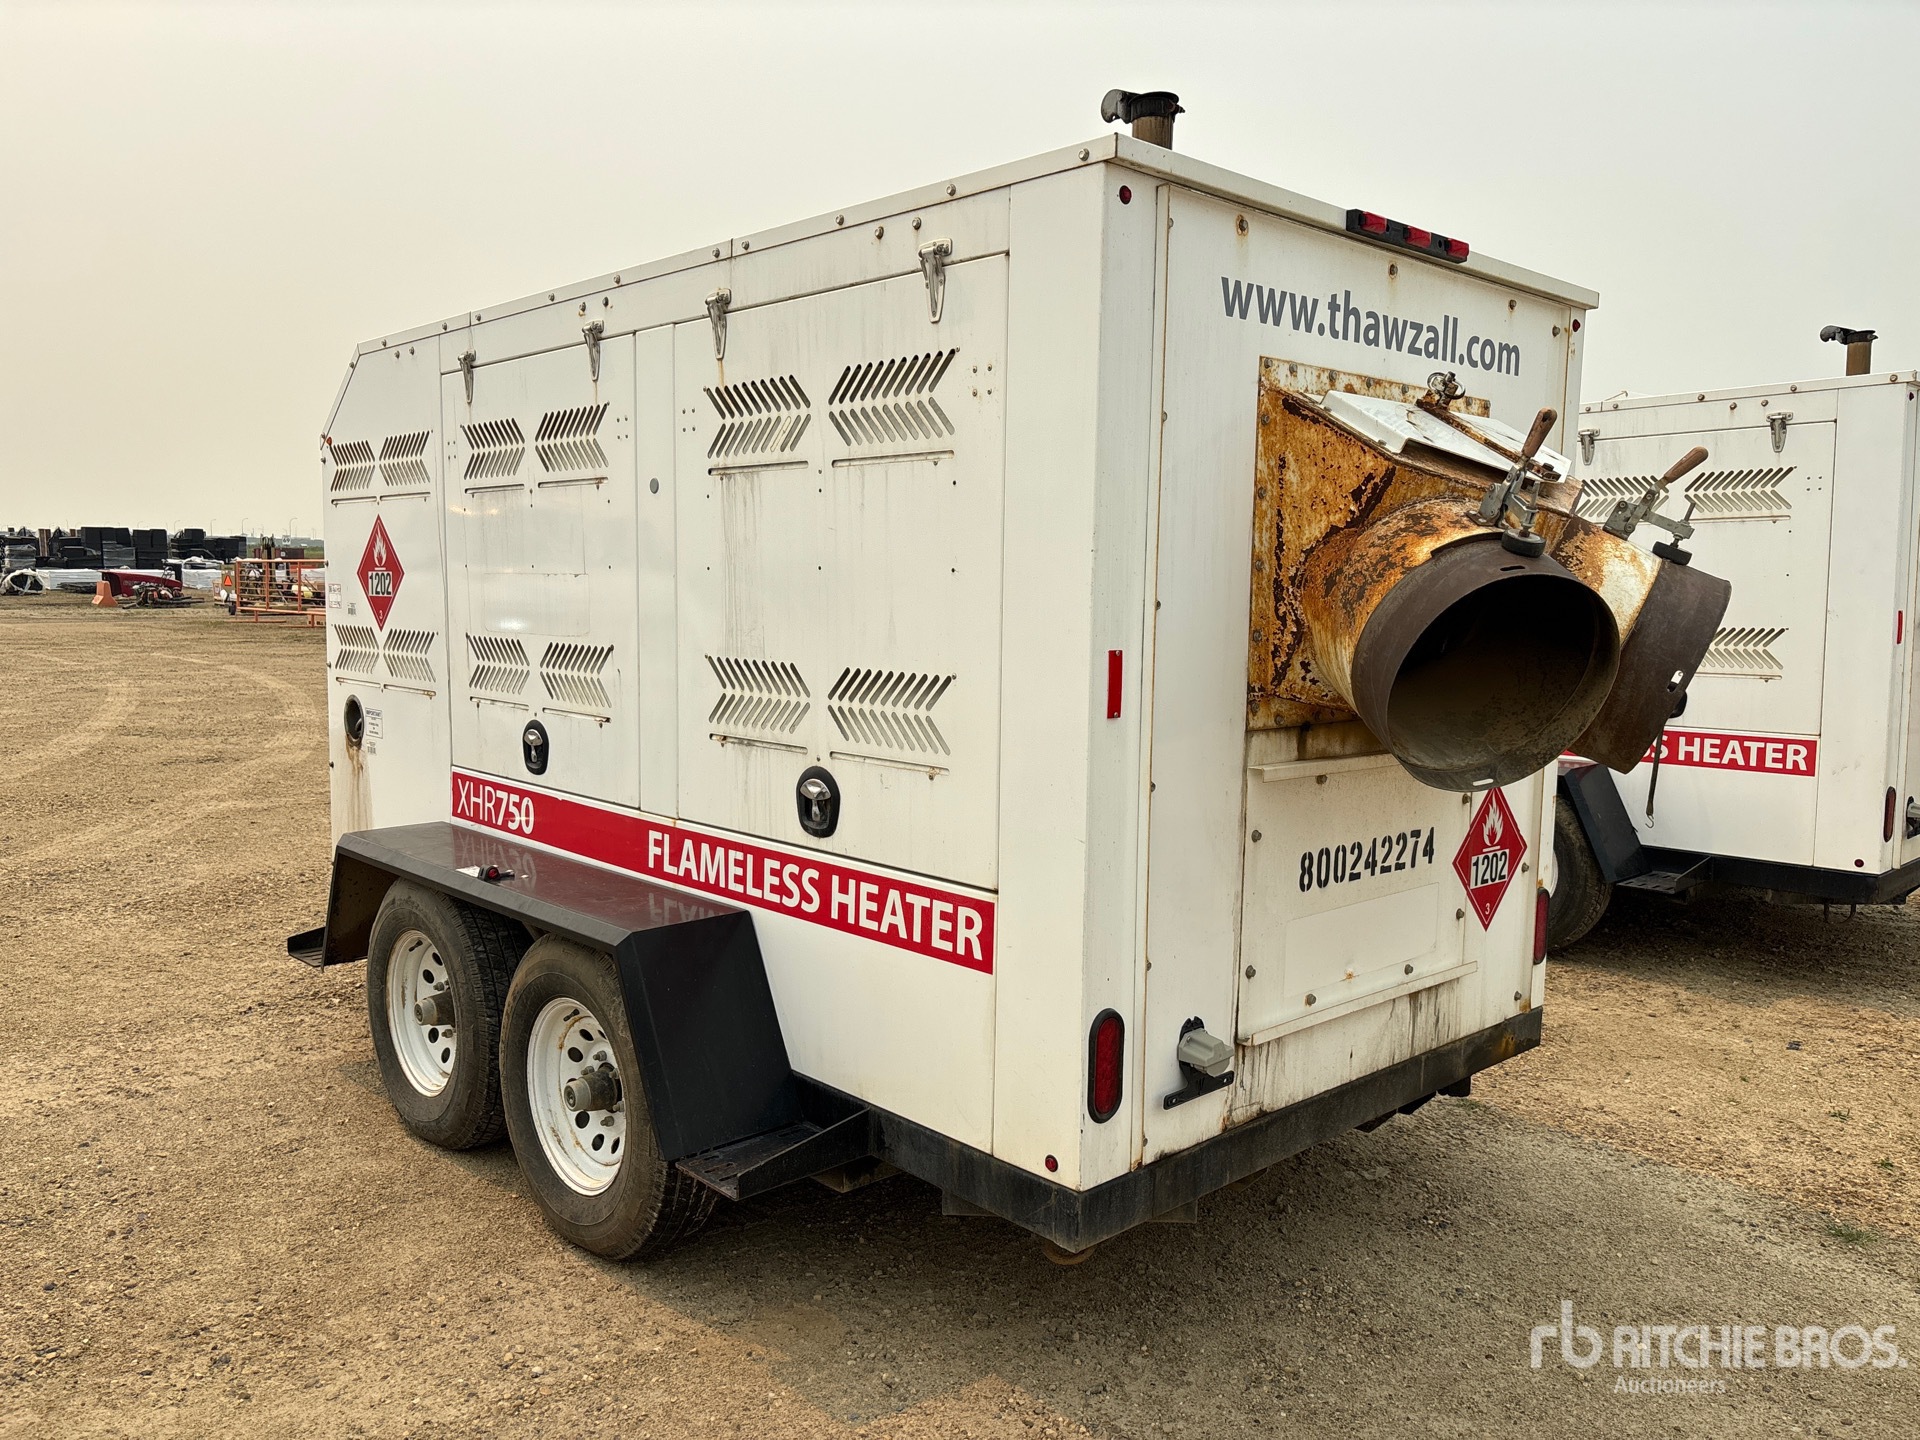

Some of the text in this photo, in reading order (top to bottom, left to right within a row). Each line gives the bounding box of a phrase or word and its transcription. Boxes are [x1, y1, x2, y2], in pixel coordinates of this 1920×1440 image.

[1220, 275, 1521, 377] www.thawzall.com
[369, 572, 392, 596] 1202
[379, 610, 384, 620] 3
[1677, 736, 1808, 772] HEATER
[456, 777, 535, 835] XHR750
[1299, 826, 1435, 893] 800242274
[1472, 851, 1508, 887] 1202
[648, 829, 983, 962] FLAMELESS HEATER
[1484, 903, 1491, 915] 3
